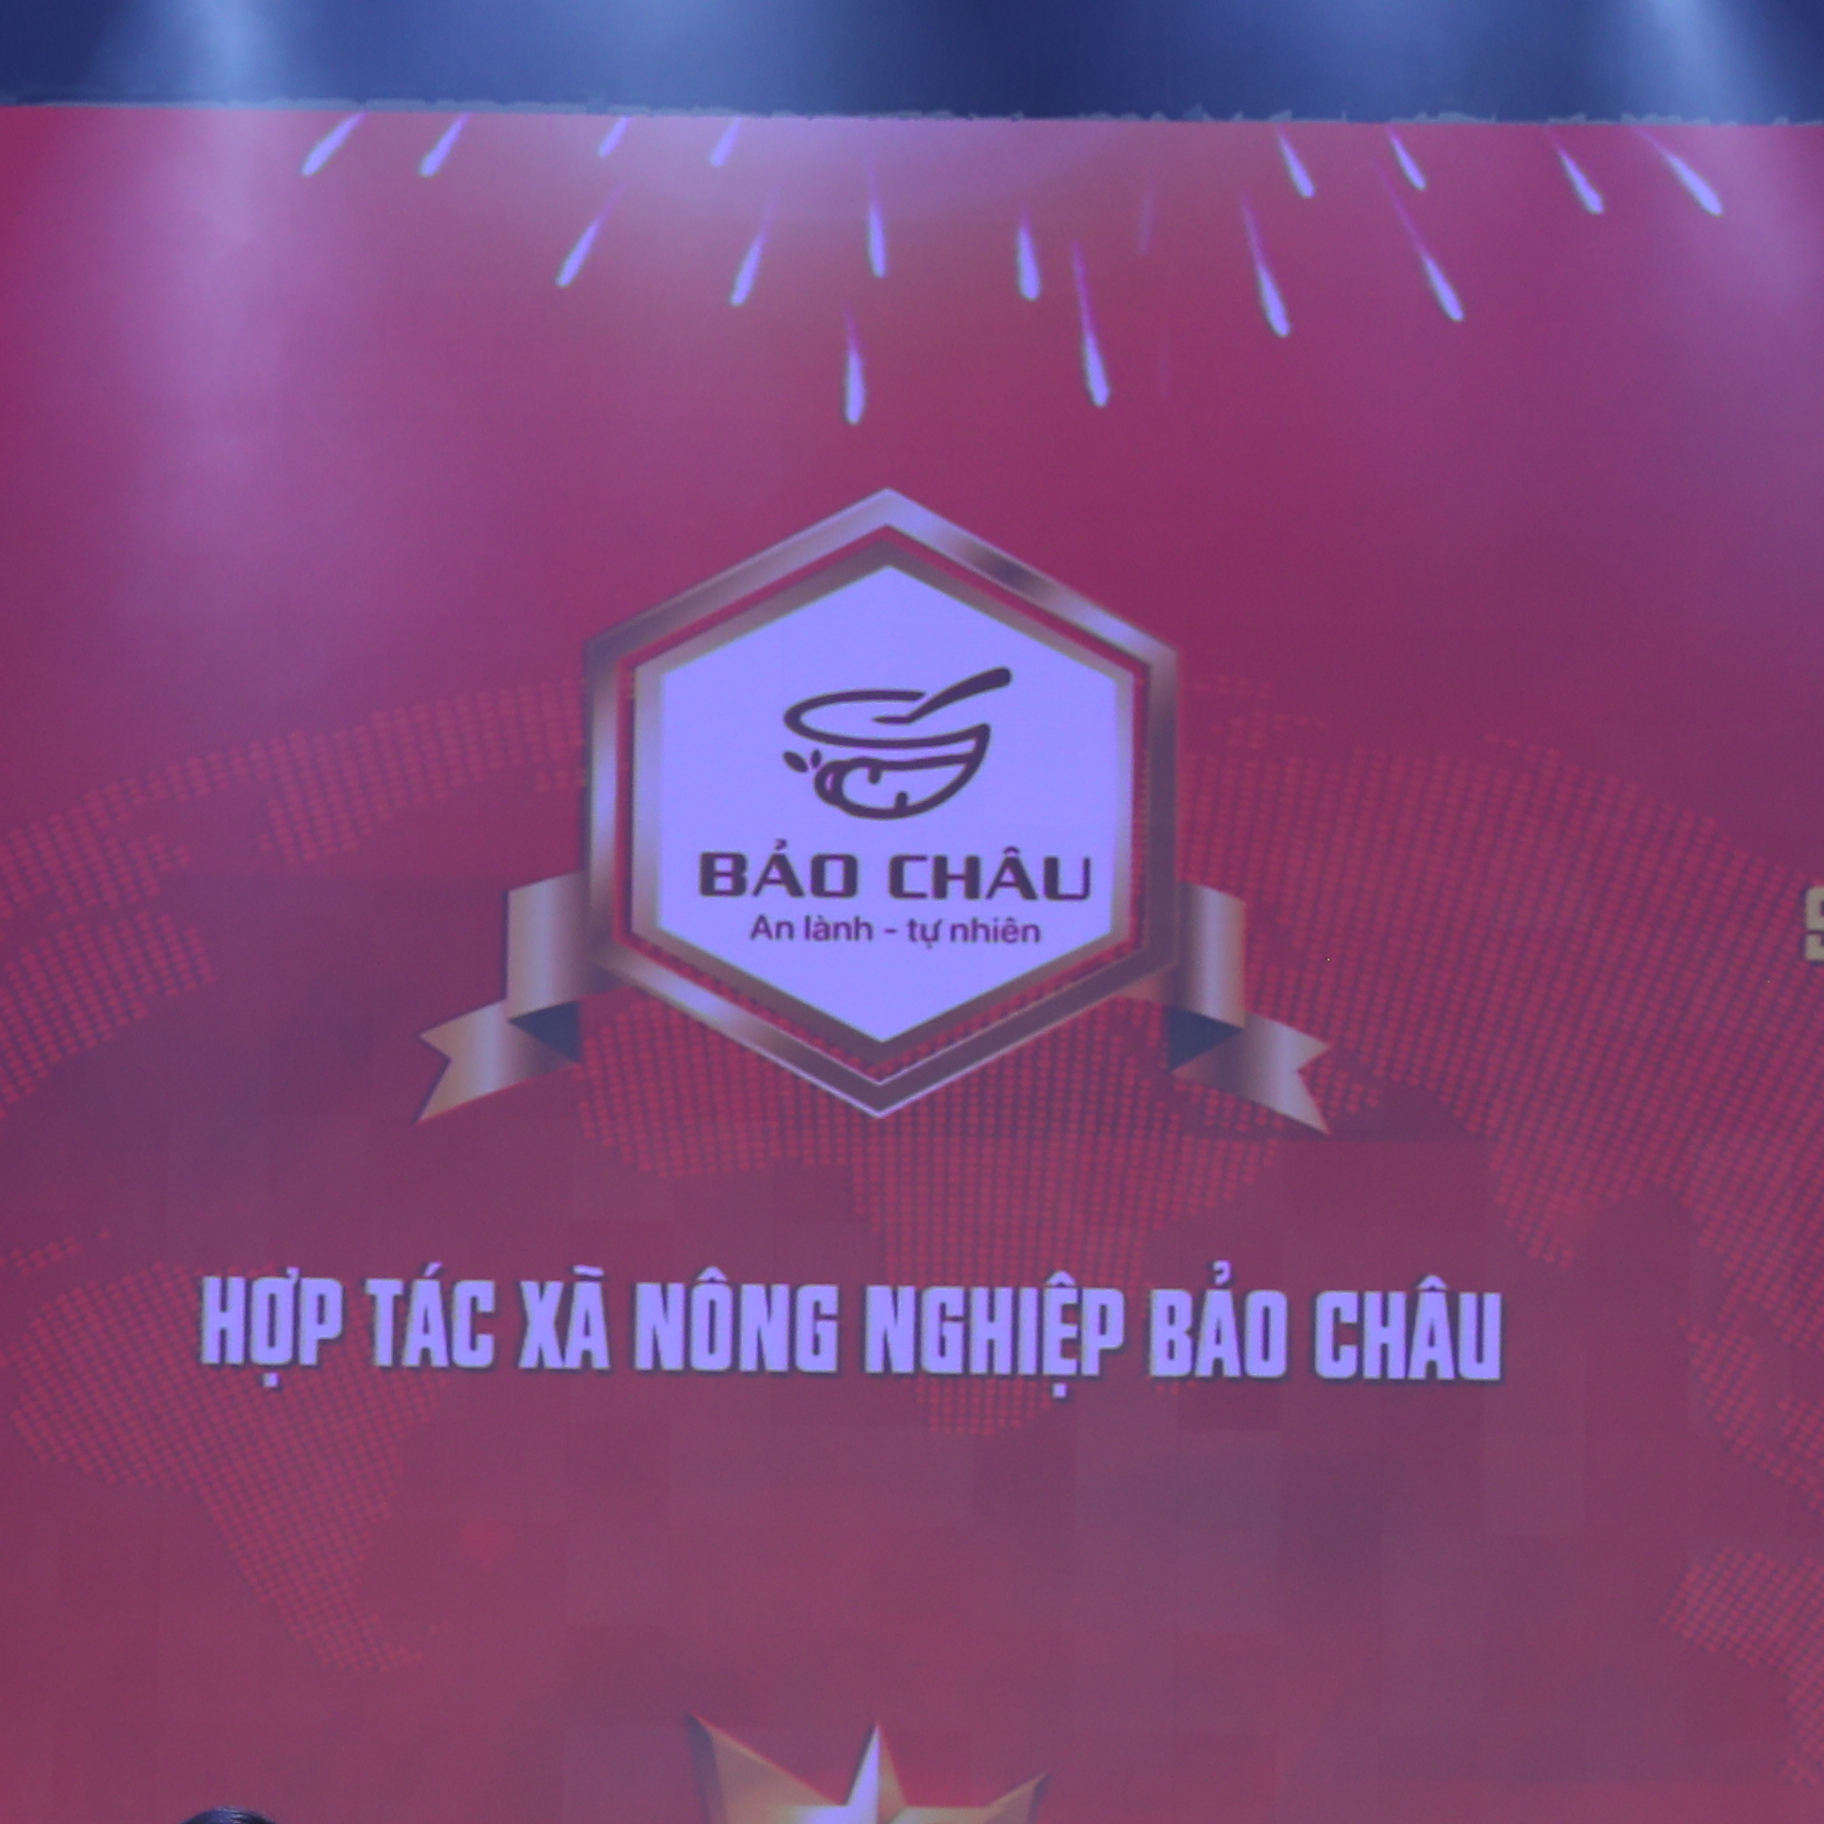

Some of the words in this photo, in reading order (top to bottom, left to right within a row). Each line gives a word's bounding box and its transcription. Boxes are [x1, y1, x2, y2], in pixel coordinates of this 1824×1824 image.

[698, 839, 858, 898] BẢO
[888, 846, 1091, 901] CHÂU
[750, 914, 795, 941] An
[805, 914, 873, 942] lành
[908, 918, 942, 949] tự
[950, 916, 1041, 943] nhiên
[200, 1266, 343, 1388] HỢP
[365, 1262, 495, 1368] TÁC
[518, 1264, 610, 1370] XÃ
[634, 1265, 839, 1373] NÔNG
[865, 1270, 1124, 1399] NGHIỆP
[1149, 1260, 1288, 1378] BẢO
[1315, 1274, 1502, 1381] CHÂU
